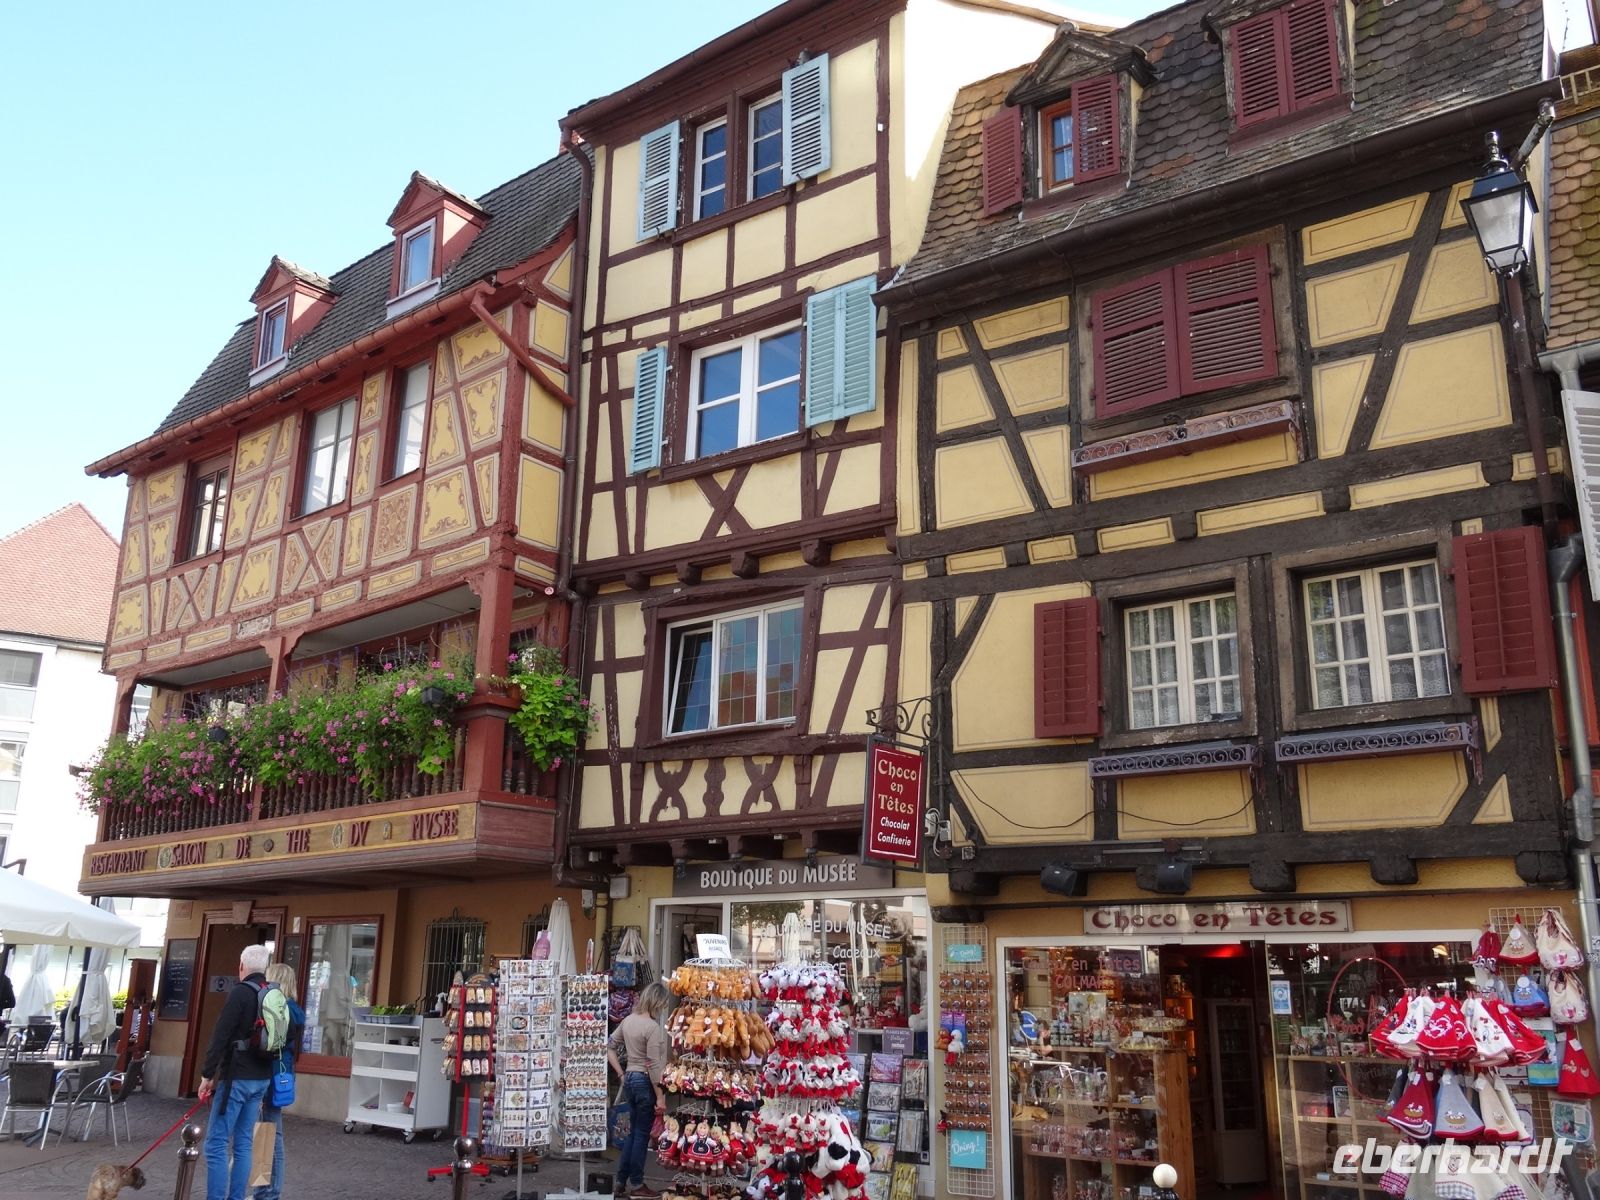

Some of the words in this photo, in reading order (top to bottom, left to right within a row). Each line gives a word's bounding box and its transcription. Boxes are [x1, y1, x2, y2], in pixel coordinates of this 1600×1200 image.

[878, 759, 917, 781] Choco
[890, 782, 904, 795] en
[878, 793, 914, 815] Têtes
[880, 816, 910, 831] Chocolat
[235, 836, 252, 859] DE
[877, 831, 912, 847] Confiserie
[700, 868, 773, 889] BOUTIQUE
[779, 869, 797, 885] DU
[802, 859, 857, 884] MUSÉE
[825, 920, 842, 934] DU
[1091, 909, 1178, 932] Choco
[1193, 913, 1230, 930] en
[1243, 906, 1338, 927] Têtes
[1071, 959, 1088, 971] en
